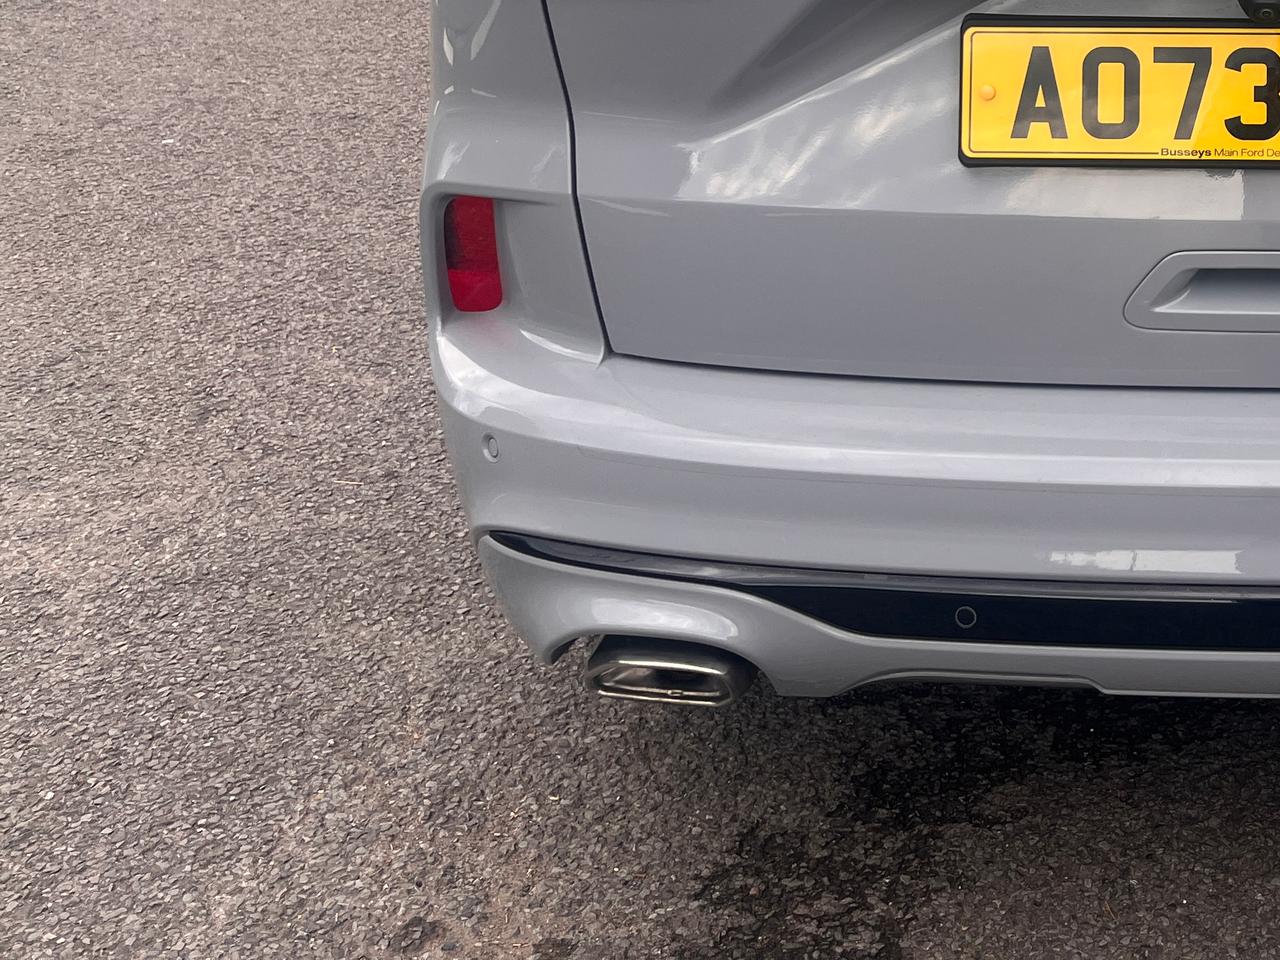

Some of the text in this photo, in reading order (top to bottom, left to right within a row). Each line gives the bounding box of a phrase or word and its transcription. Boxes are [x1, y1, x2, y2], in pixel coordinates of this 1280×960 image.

[1160, 148, 1212, 158] Busseys
[1214, 148, 1239, 157] Main
[1241, 148, 1264, 157] Ford
